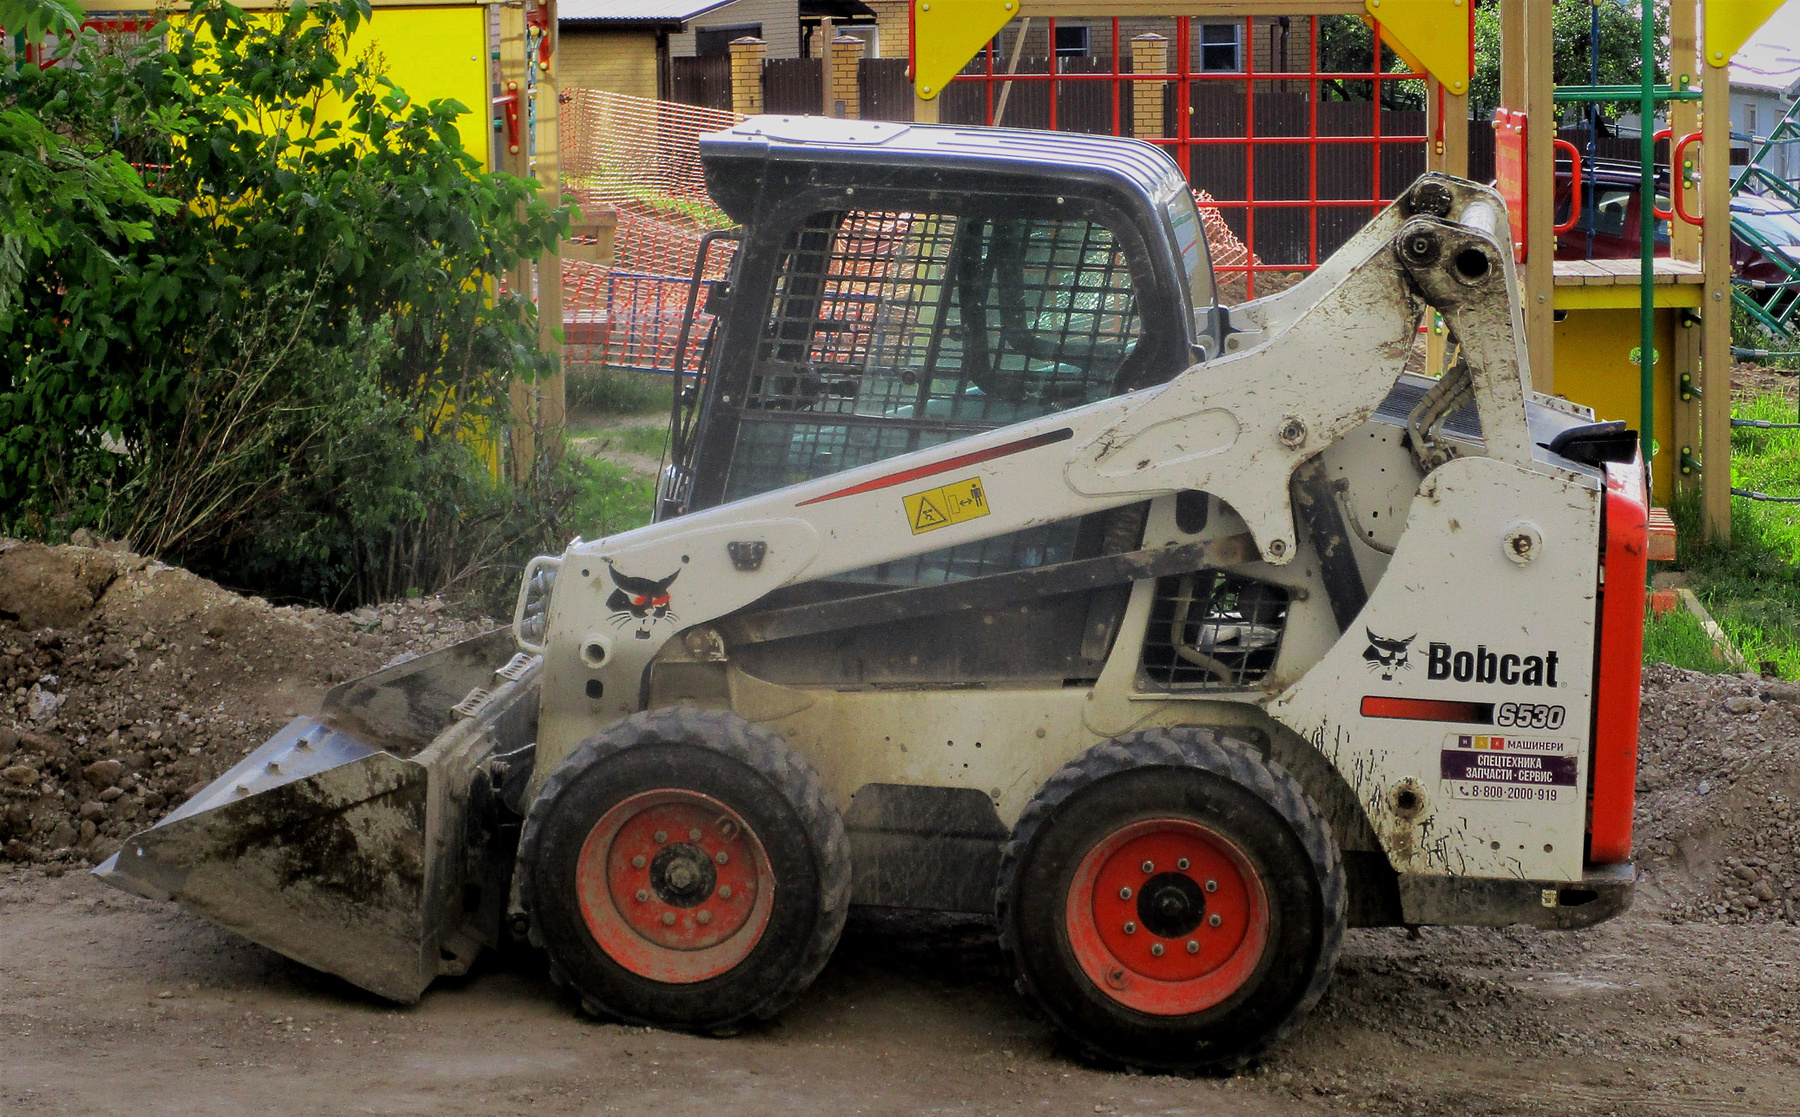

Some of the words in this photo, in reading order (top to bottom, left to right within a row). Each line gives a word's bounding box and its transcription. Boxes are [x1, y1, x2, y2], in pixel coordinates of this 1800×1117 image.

[1428, 641, 1558, 688] Bobcat
[1498, 702, 1566, 730] S530
[1508, 740, 1564, 752] МАШИНЕРИ
[1477, 754, 1542, 769] СПЕЦТЕХНИКА
[1465, 767, 1512, 780] ЗАПЧАСТИ
[1518, 770, 1553, 783] СЕРВИС
